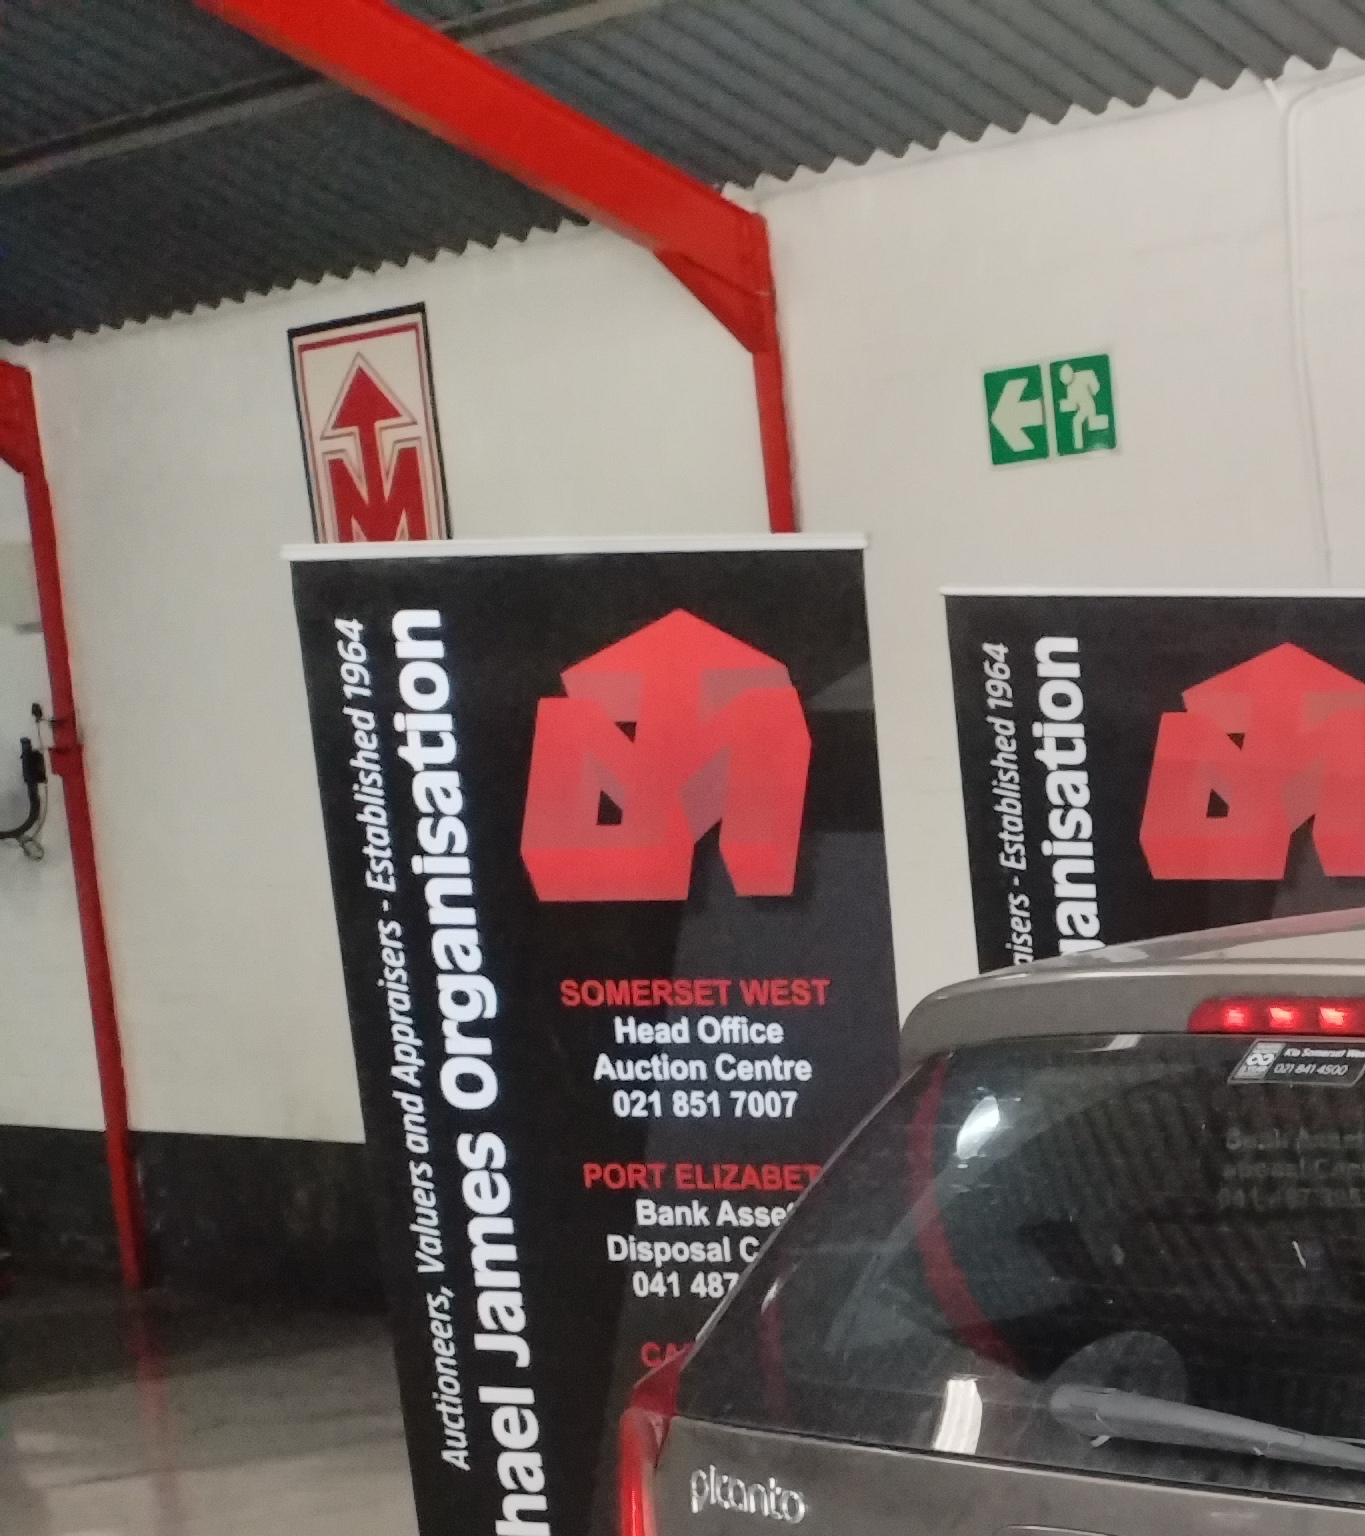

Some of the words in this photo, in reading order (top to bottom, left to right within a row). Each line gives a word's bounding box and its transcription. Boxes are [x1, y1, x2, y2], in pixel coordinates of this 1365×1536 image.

[334, 617, 373, 700] 1964
[982, 642, 1014, 710] 1964
[343, 706, 397, 893] Established
[986, 715, 1027, 871] Established
[391, 609, 499, 1110] Organisation
[378, 919, 426, 1088] Appraisers
[560, 978, 732, 1007] SOMERSET
[739, 978, 831, 1007] WEST
[614, 1015, 691, 1045] Head
[697, 1015, 785, 1045] Office
[593, 1053, 708, 1082] Auction
[714, 1053, 813, 1082] Centre
[392, 1090, 430, 1154] and
[612, 1089, 662, 1118] 021
[672, 1089, 721, 1119] 851
[730, 1090, 799, 1119] 7007
[583, 1162, 667, 1190] PORT
[409, 1160, 445, 1273] Valuers
[636, 1199, 711, 1227] Bank
[716, 1199, 795, 1228] Asse
[457, 1131, 531, 1368] James
[606, 1234, 732, 1268] Disposal
[632, 1270, 681, 1298] 041
[690, 1271, 740, 1298] 487
[426, 1286, 471, 1471] Auctioneers,
